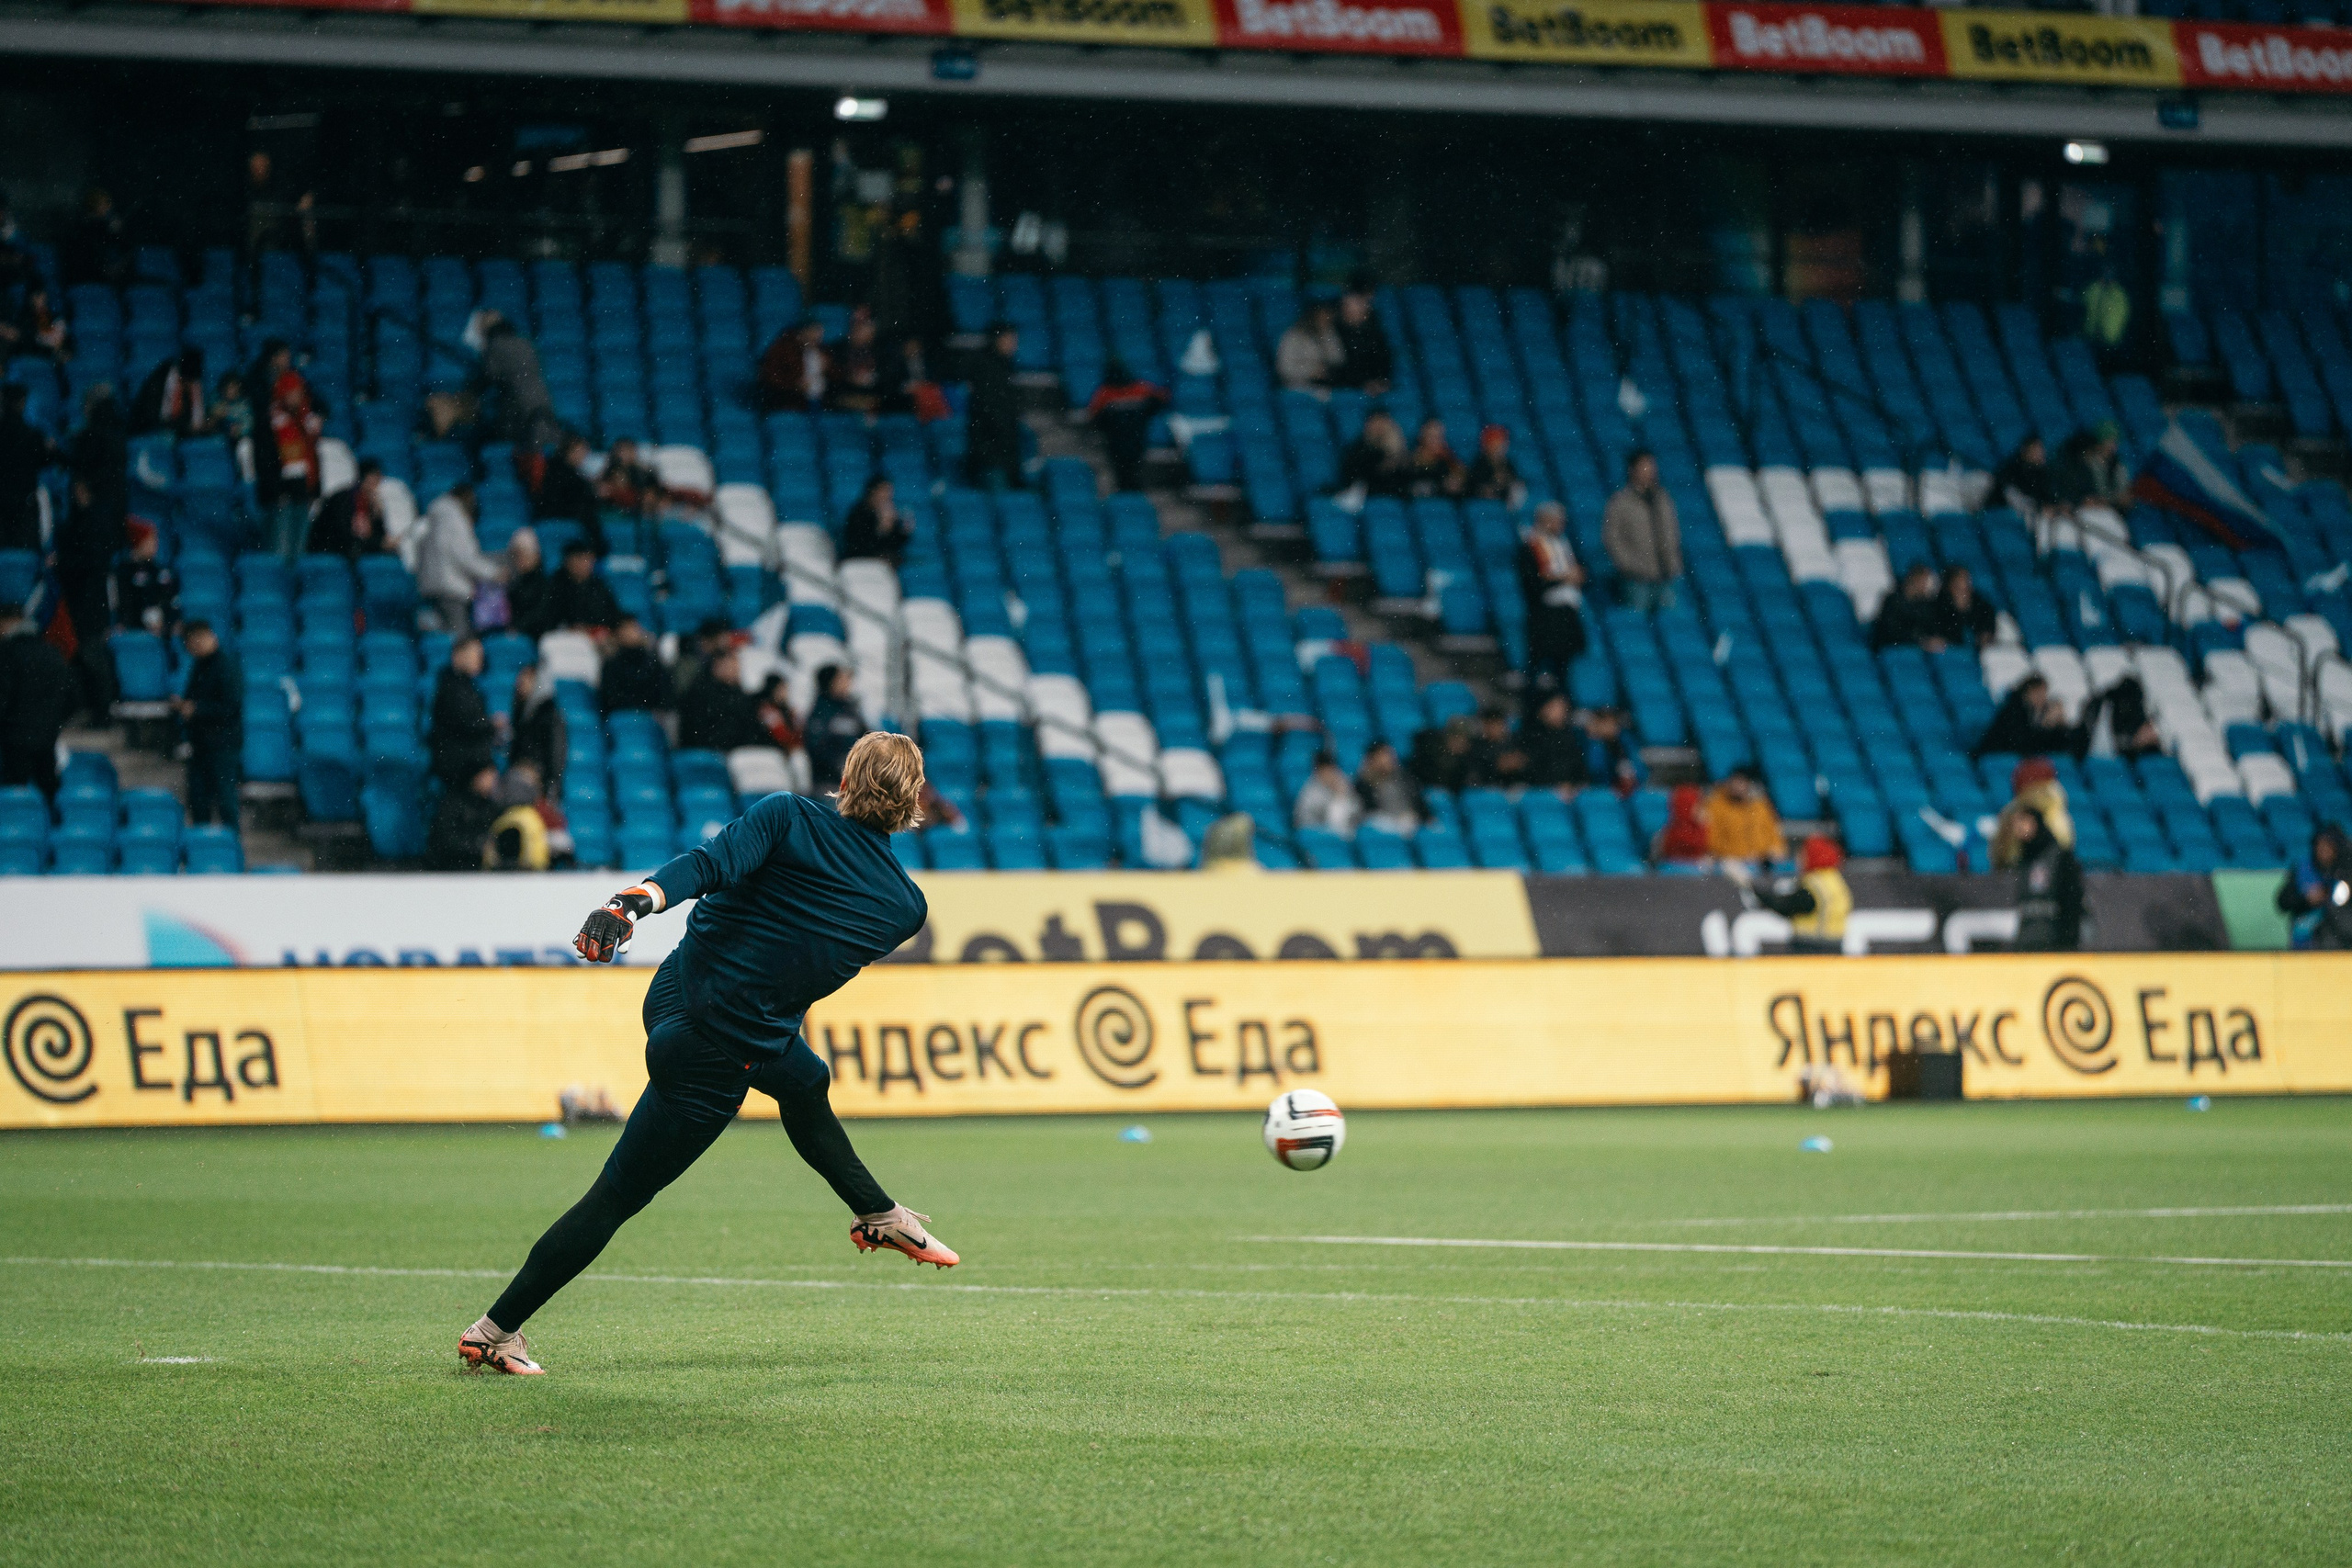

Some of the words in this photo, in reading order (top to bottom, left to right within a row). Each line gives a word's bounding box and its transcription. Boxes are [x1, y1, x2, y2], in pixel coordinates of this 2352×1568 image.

[1488, 6, 1685, 50] BetBoom
[1727, 10, 1926, 63] BetBoom
[1969, 24, 2155, 70] BetBoom
[2196, 31, 2352, 84] BetBoo
[122, 1007, 280, 1103] Еда
[804, 1012, 1054, 1095] ндекс
[1182, 997, 1322, 1086] Еда
[2137, 987, 2263, 1075] Еда
